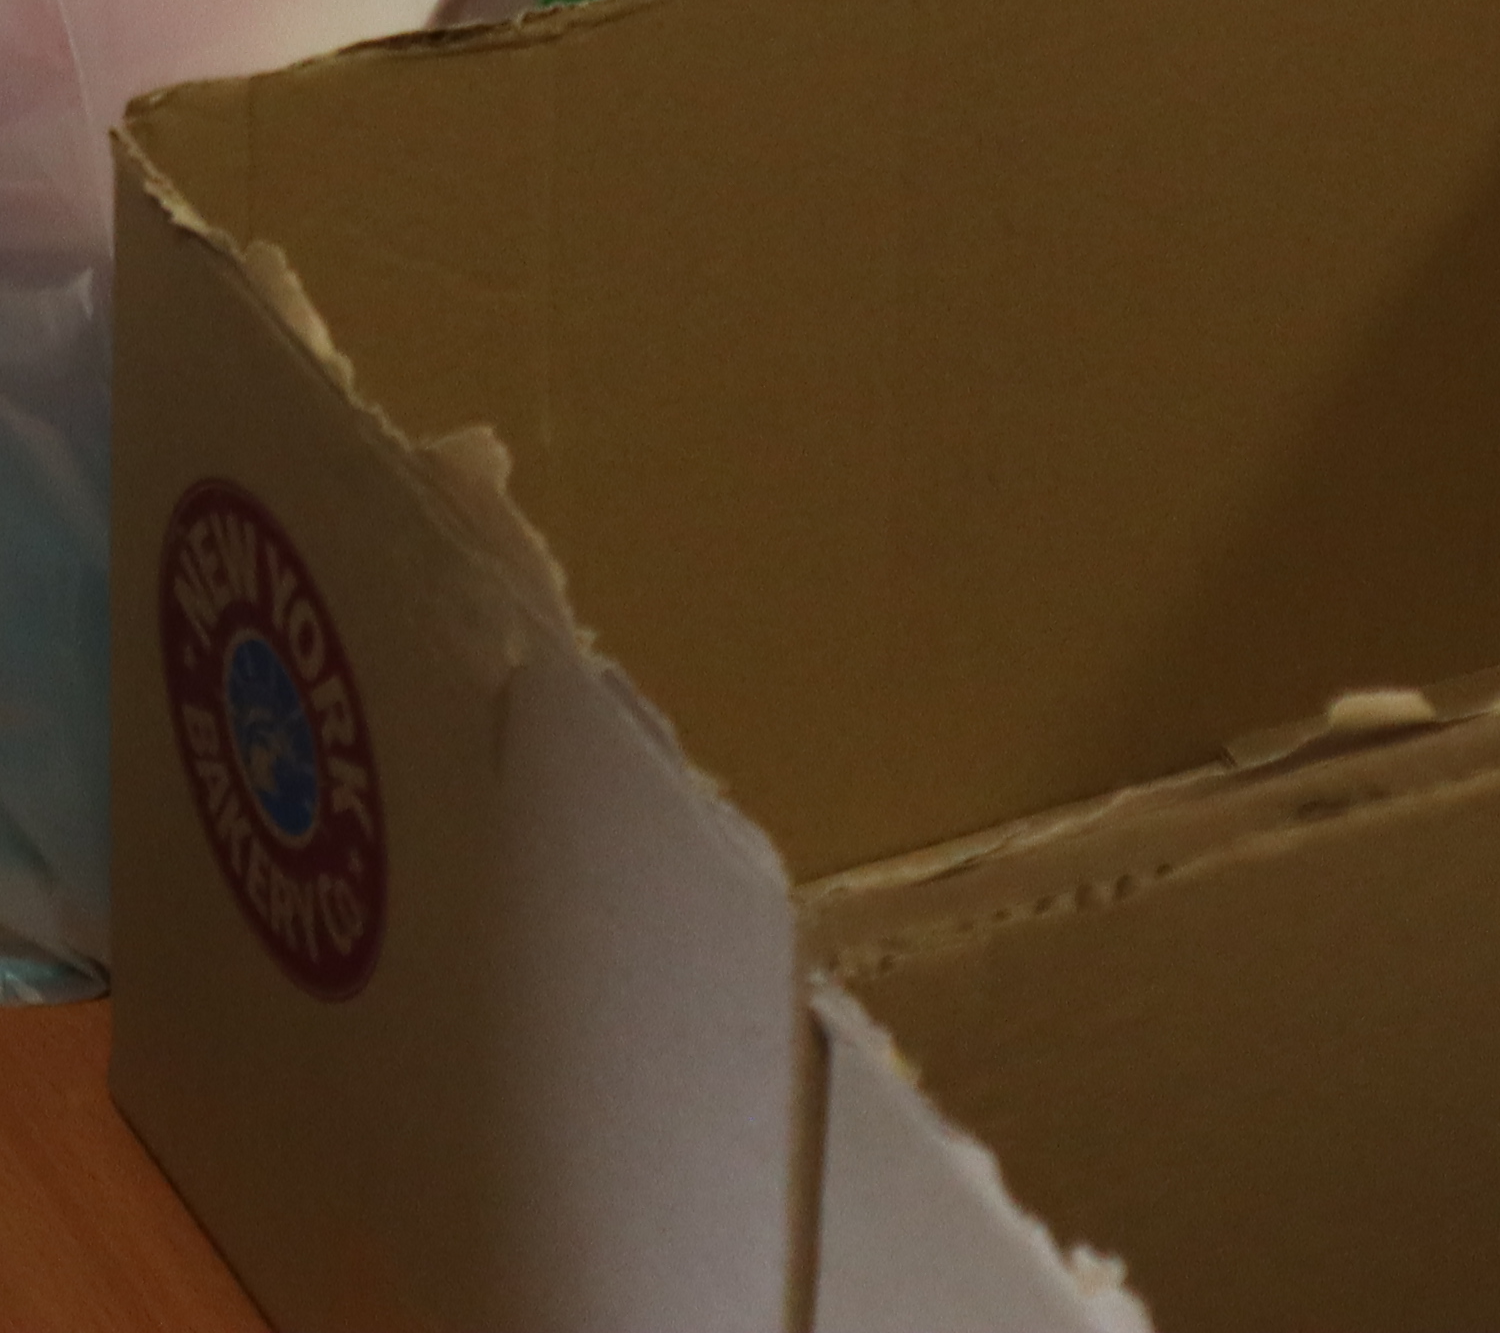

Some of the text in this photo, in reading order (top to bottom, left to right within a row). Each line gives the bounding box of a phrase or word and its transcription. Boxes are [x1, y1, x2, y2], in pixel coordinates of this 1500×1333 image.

[175, 513, 370, 850] NEW YORK
[182, 703, 320, 964] BAKERY
